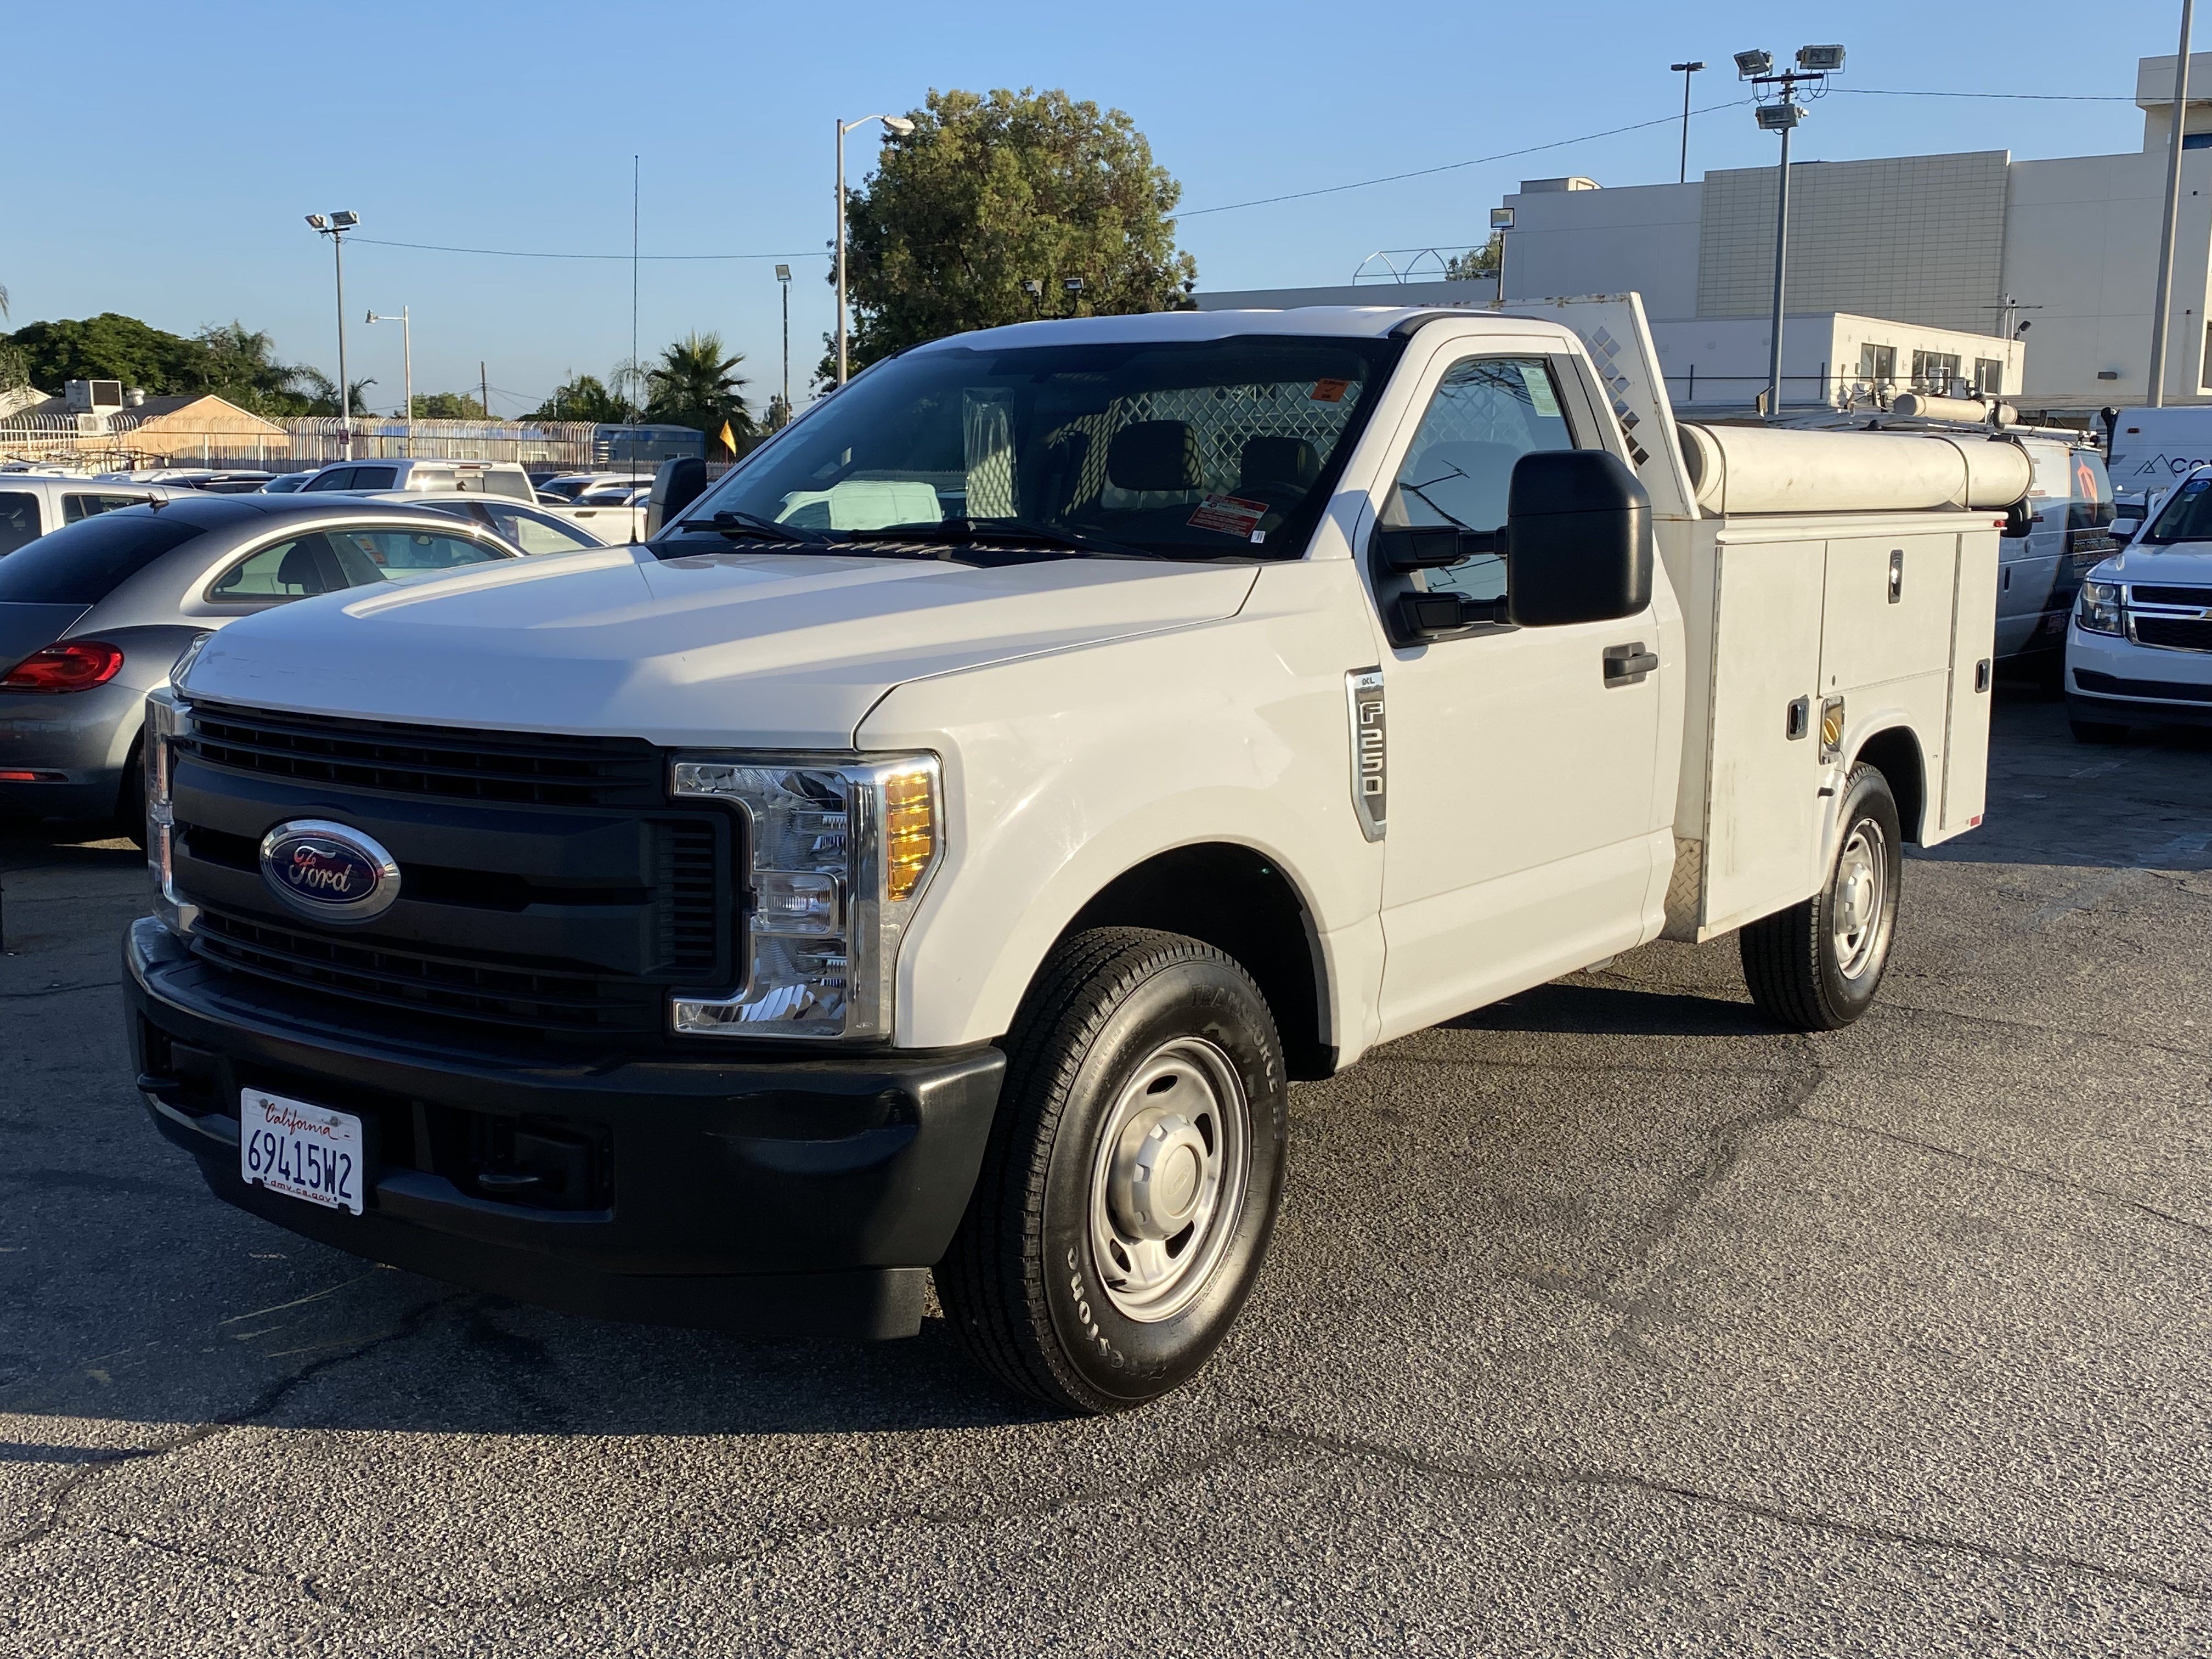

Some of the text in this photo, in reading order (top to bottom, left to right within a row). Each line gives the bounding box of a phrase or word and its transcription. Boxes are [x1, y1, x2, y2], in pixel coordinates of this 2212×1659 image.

[288, 845, 353, 893] Ford
[266, 1103, 338, 1141] California
[248, 1130, 352, 1199] 69415W2
[270, 1180, 331, 1203] dmv.ca.gov
